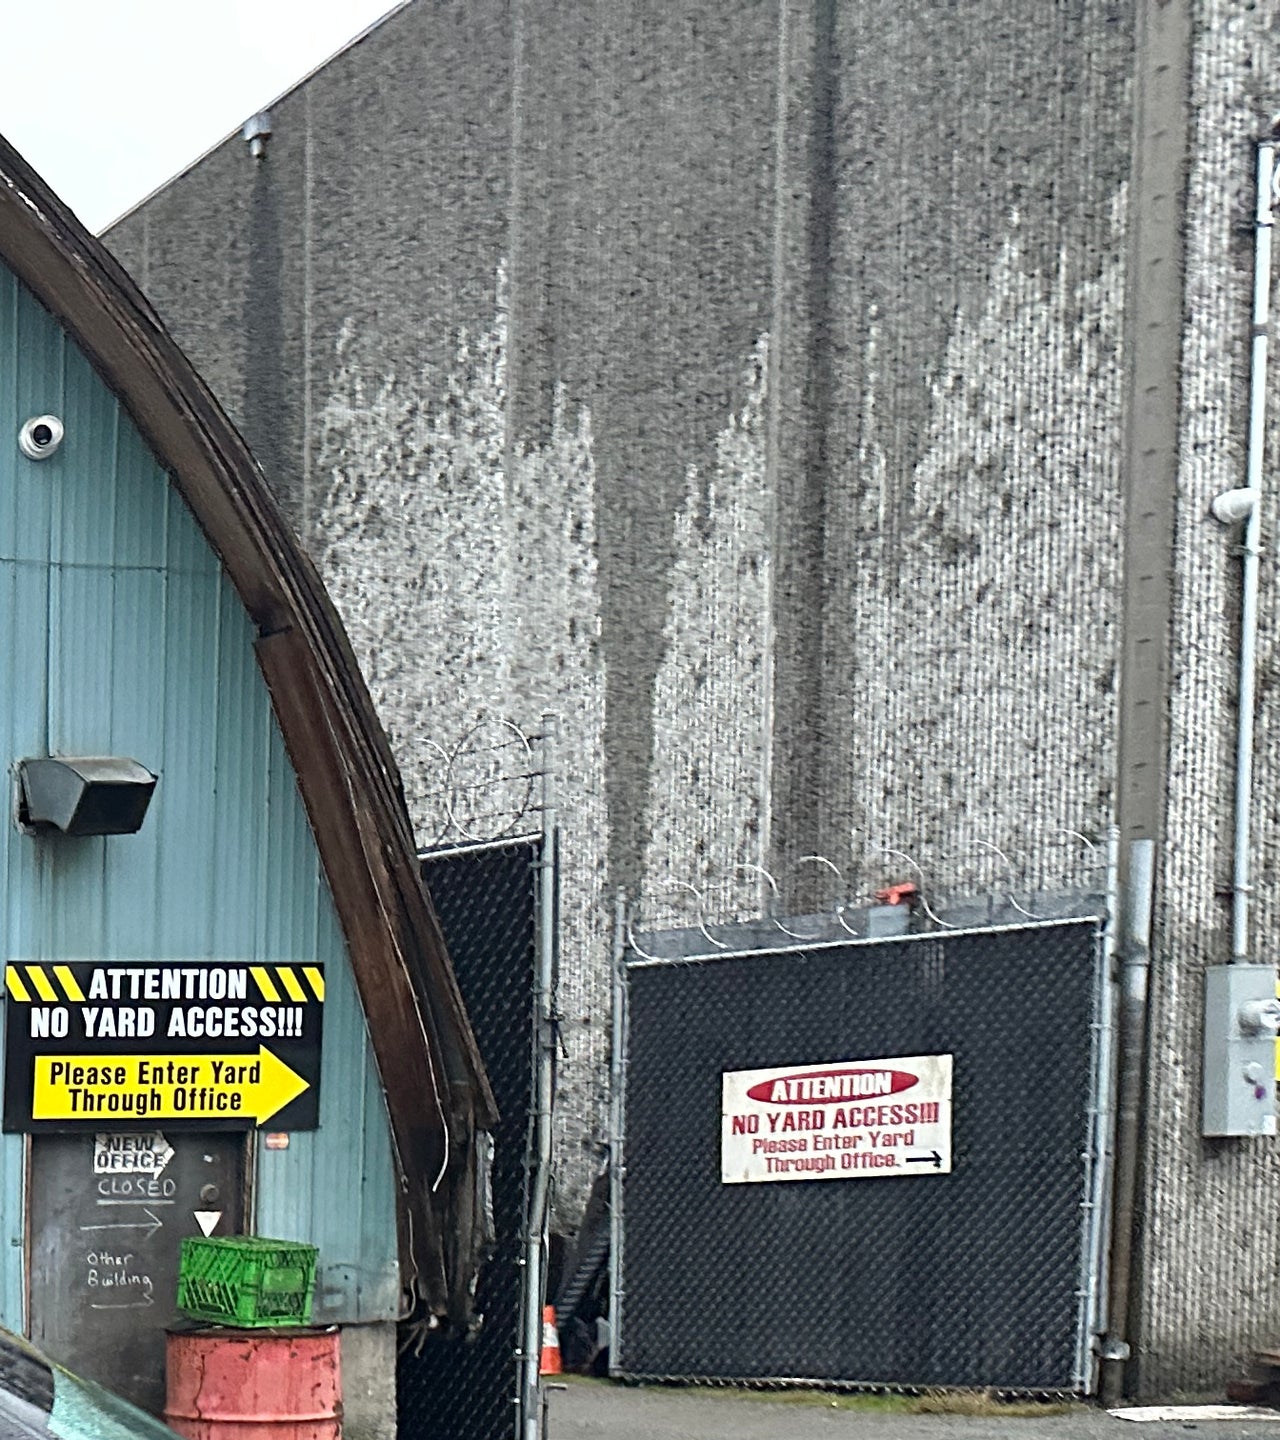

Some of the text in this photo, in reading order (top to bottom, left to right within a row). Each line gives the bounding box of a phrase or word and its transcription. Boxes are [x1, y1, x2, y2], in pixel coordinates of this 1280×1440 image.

[89, 968, 247, 1000] ATTENTION
[30, 1007, 303, 1038] NO YARD ACCESS!!!
[50, 1060, 261, 1086] Please Enter Yard
[771, 1072, 892, 1102] ATTENTION
[69, 1087, 241, 1115] Through Office
[732, 1102, 939, 1135] NO YARD ACCESS!!!
[107, 1136, 154, 1151] NEW
[752, 1129, 915, 1154] Please Enter Yard
[97, 1150, 165, 1168] OFFICE
[765, 1154, 835, 1174] Through
[98, 1178, 176, 1197] CLOSED
[87, 1269, 153, 1295] Building
